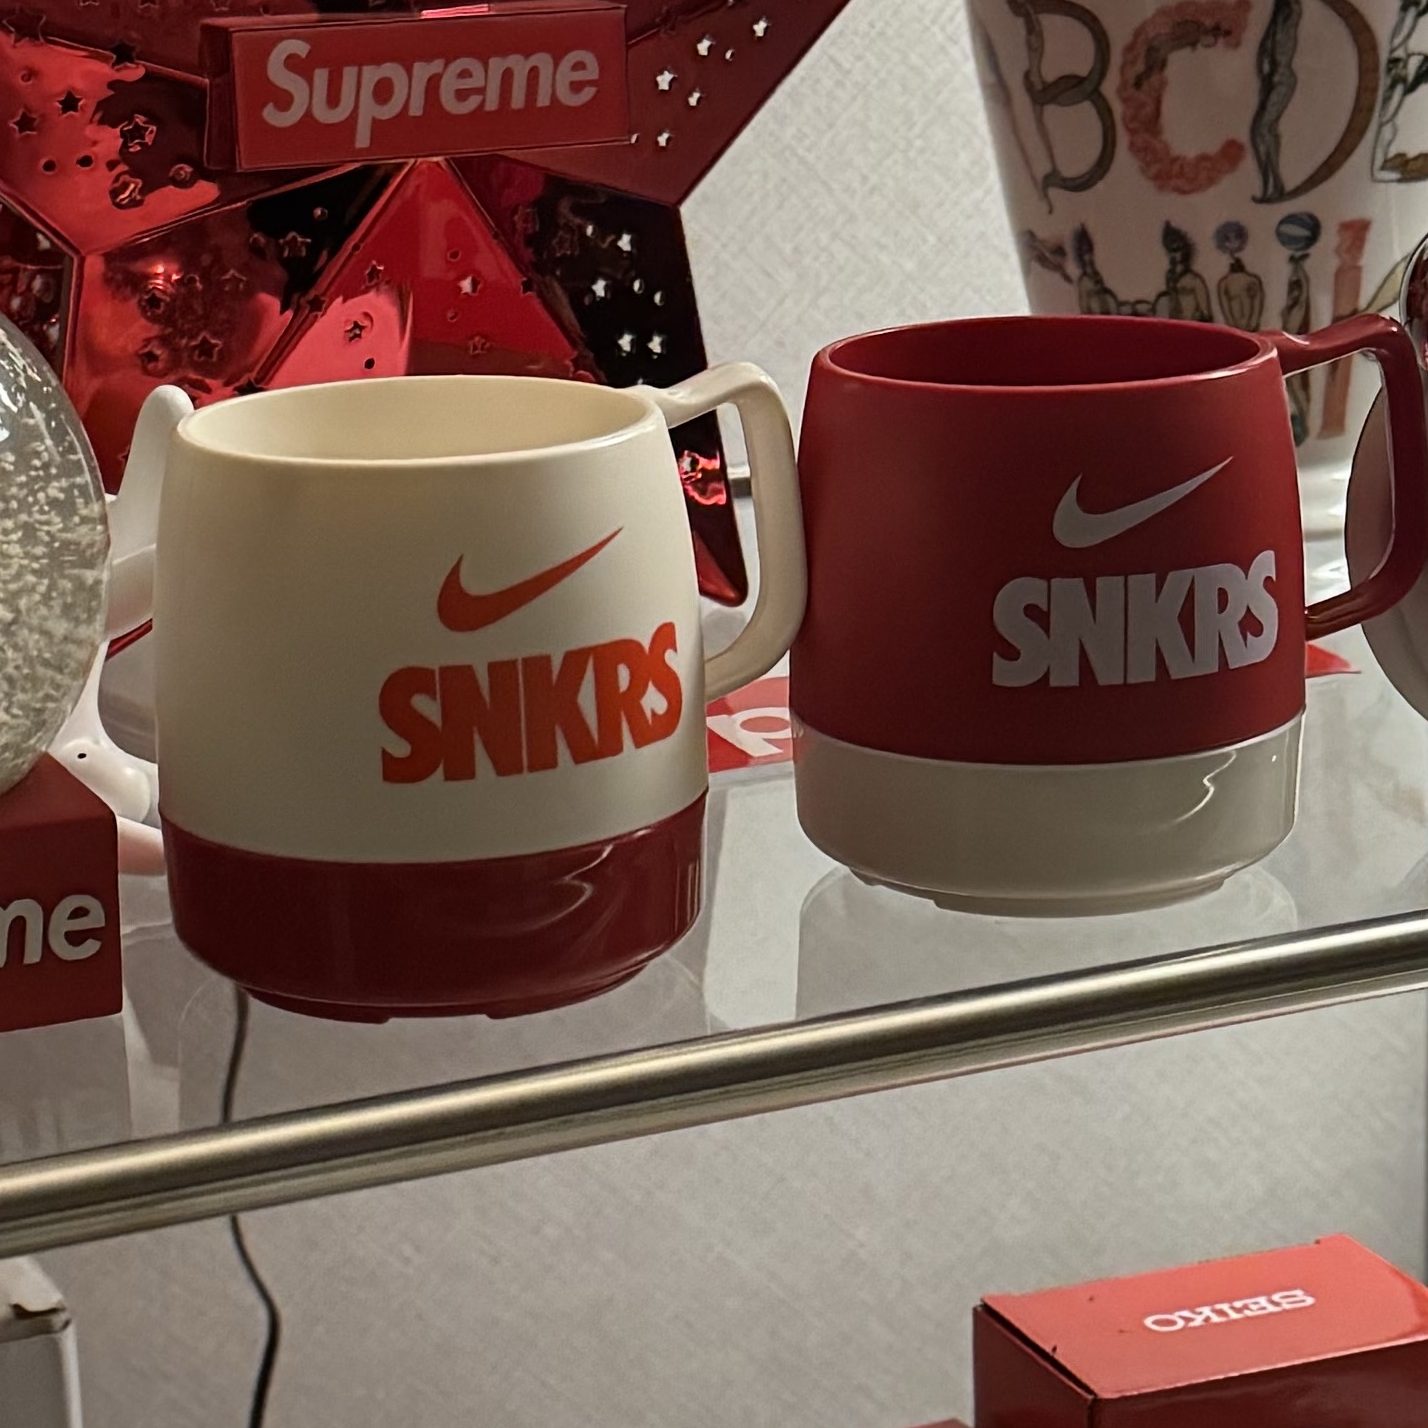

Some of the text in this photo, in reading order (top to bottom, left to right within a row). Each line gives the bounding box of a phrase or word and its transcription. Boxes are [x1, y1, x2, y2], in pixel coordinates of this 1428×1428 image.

[262, 39, 599, 147] Supreme
[992, 550, 1278, 688] SNKRS
[378, 622, 682, 784] SNKRS
[1143, 1288, 1316, 1333] SEIKO
